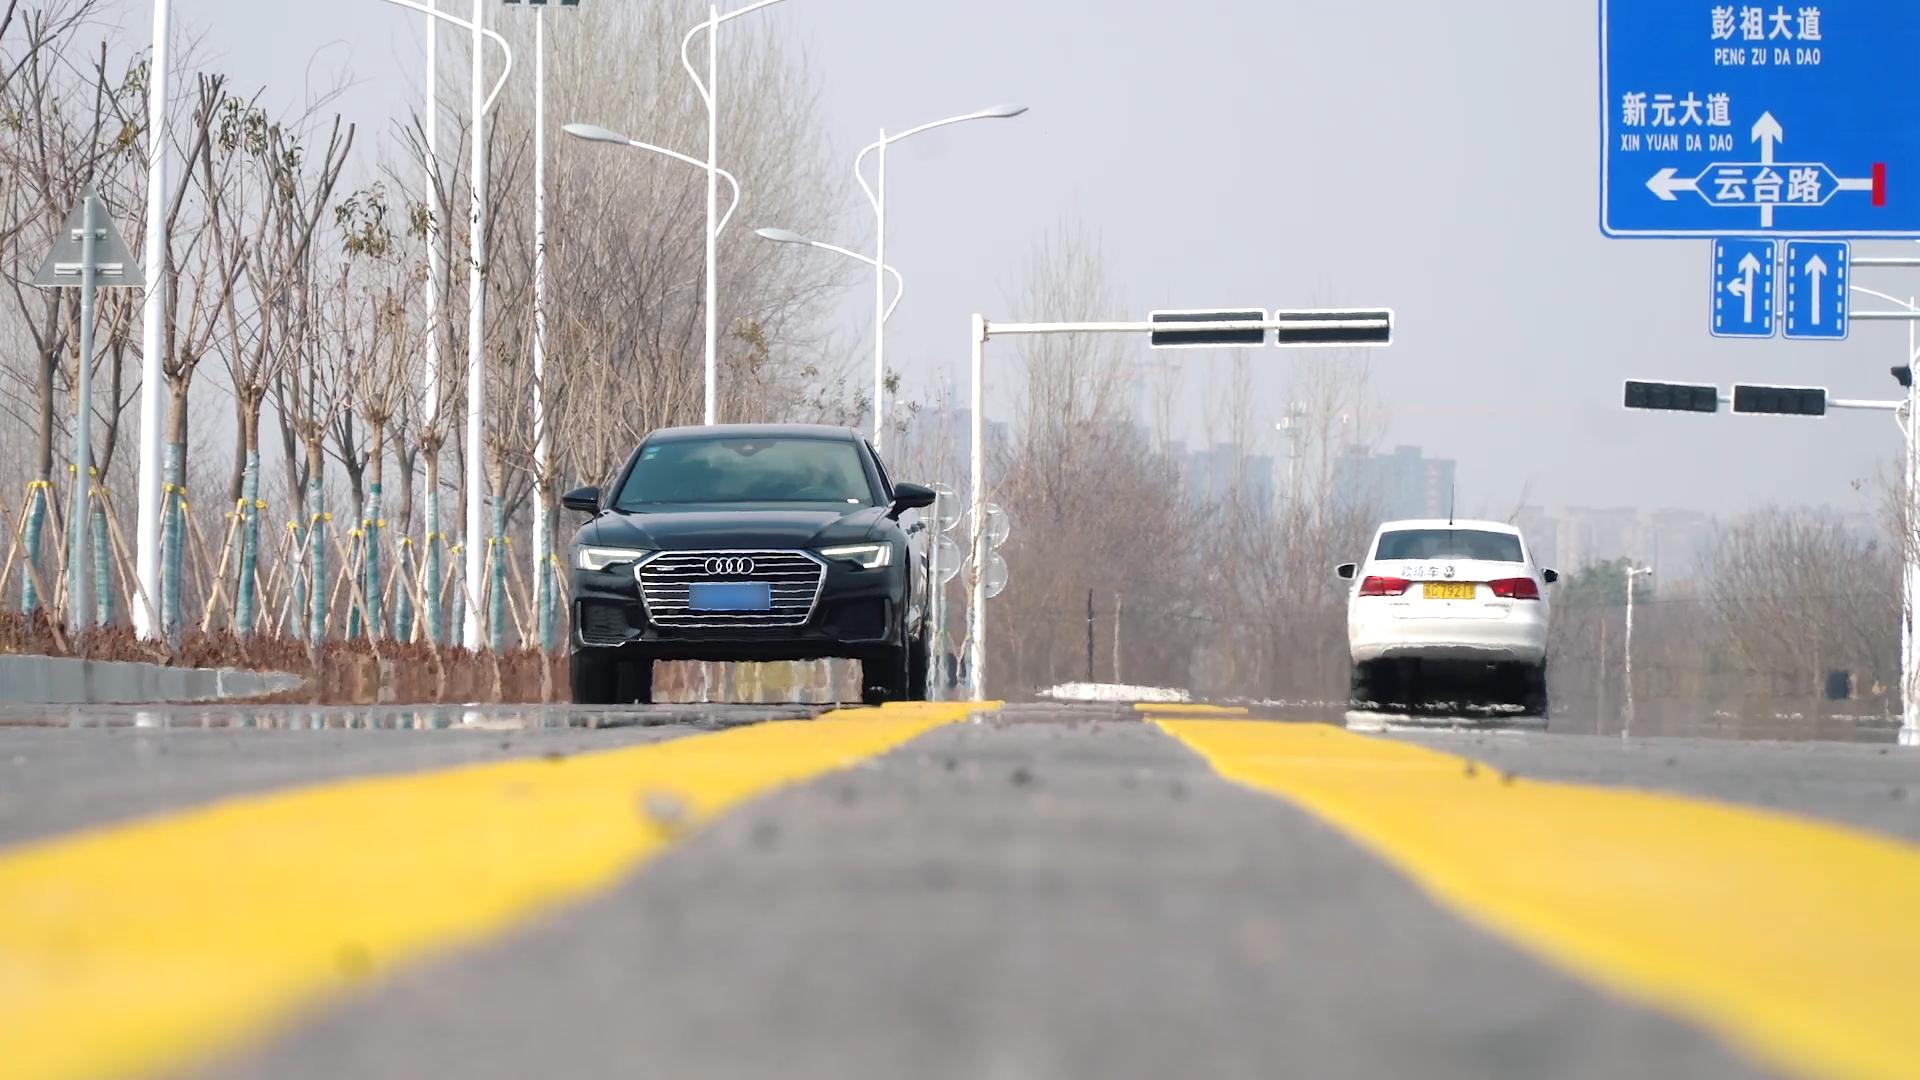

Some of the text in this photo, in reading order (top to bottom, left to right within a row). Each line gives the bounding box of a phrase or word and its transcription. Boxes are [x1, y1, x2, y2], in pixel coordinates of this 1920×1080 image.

[1711, 5, 1822, 41] 彭祖大道
[1714, 48, 1821, 65] PENG ZU DA DAO
[1622, 91, 1731, 127] 新元大道
[1621, 134, 1733, 151] XIN YUAN DA DAO
[1714, 167, 1822, 203] 云台路
